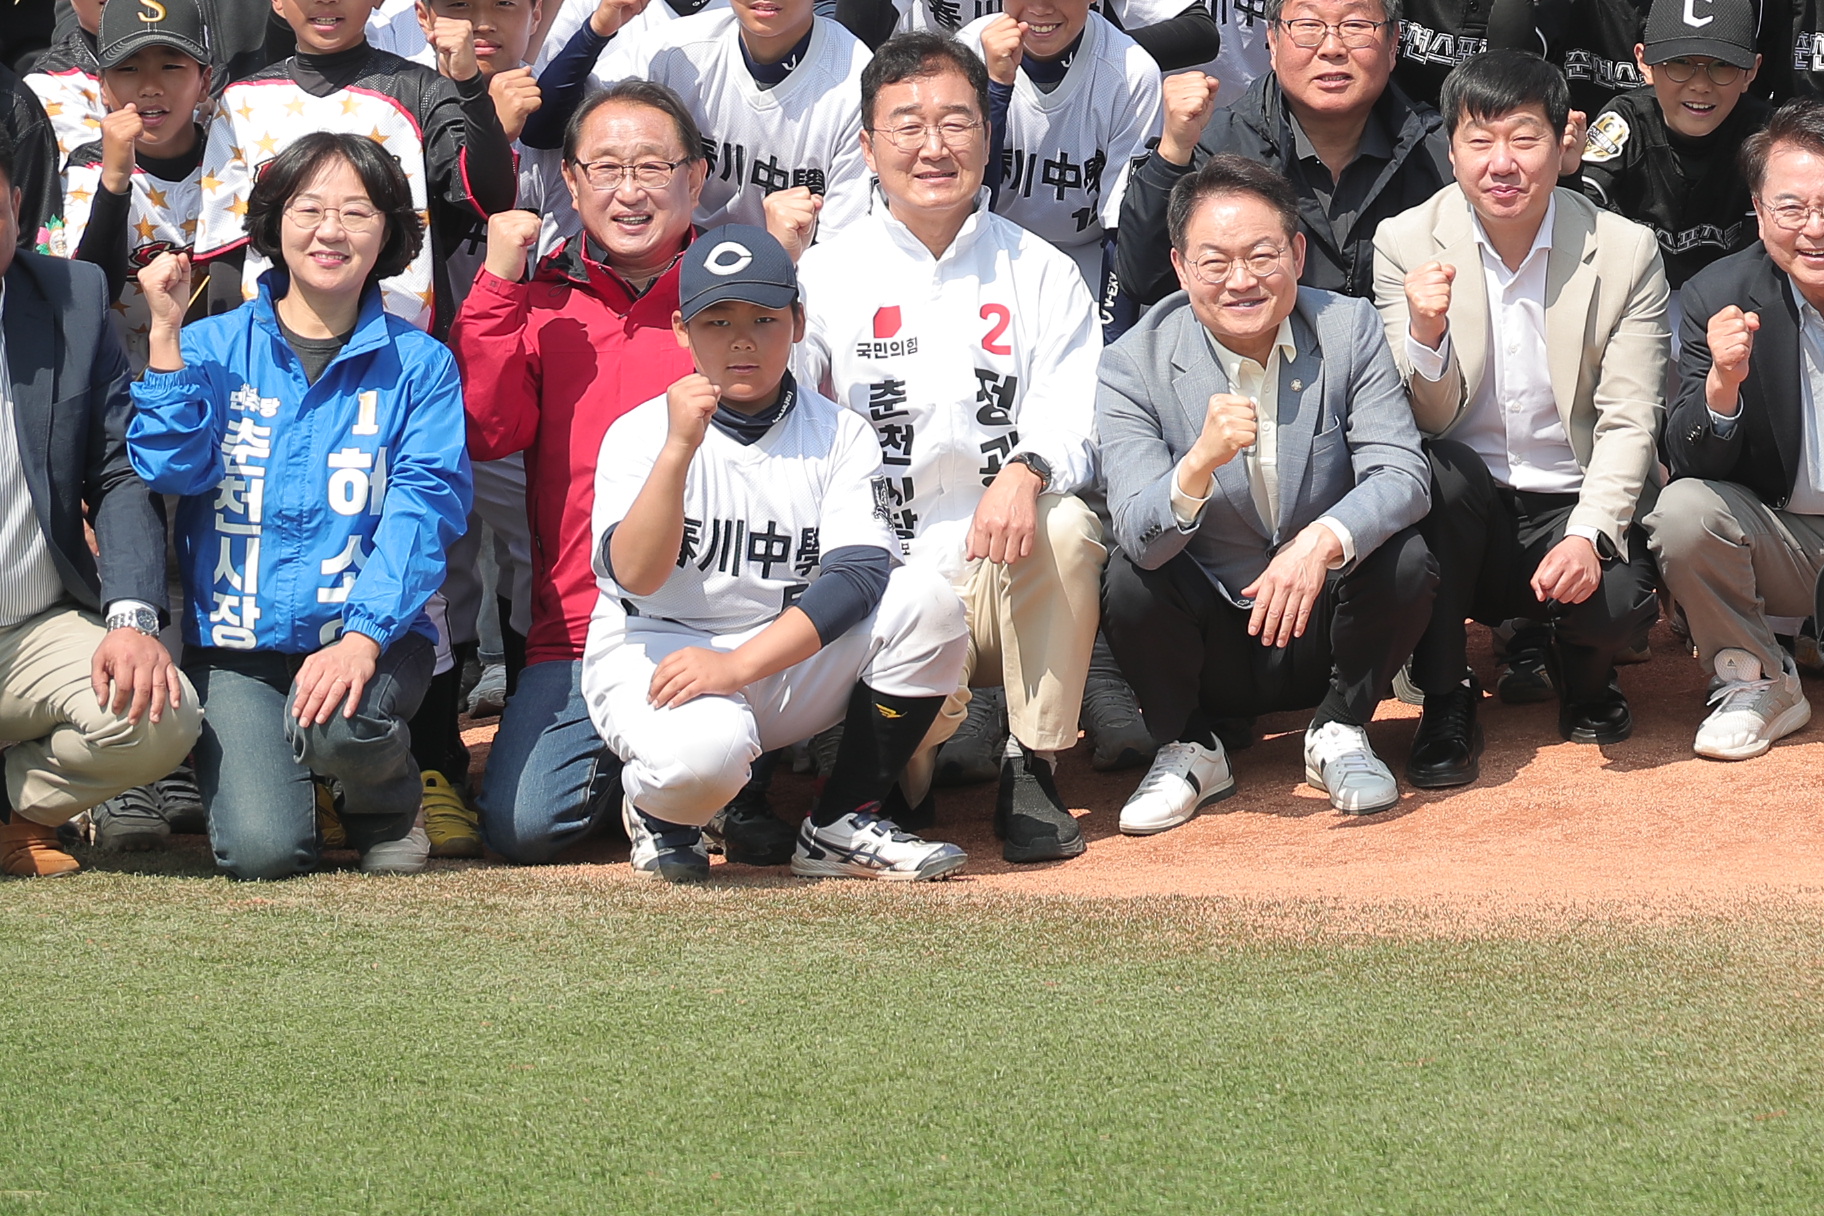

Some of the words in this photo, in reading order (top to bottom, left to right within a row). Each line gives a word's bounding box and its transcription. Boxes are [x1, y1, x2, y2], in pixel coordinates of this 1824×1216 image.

[856, 337, 918, 359] 국민의힘
[979, 303, 1011, 355] 2
[352, 390, 378, 435] 1
[209, 417, 271, 650] 춘천시장
